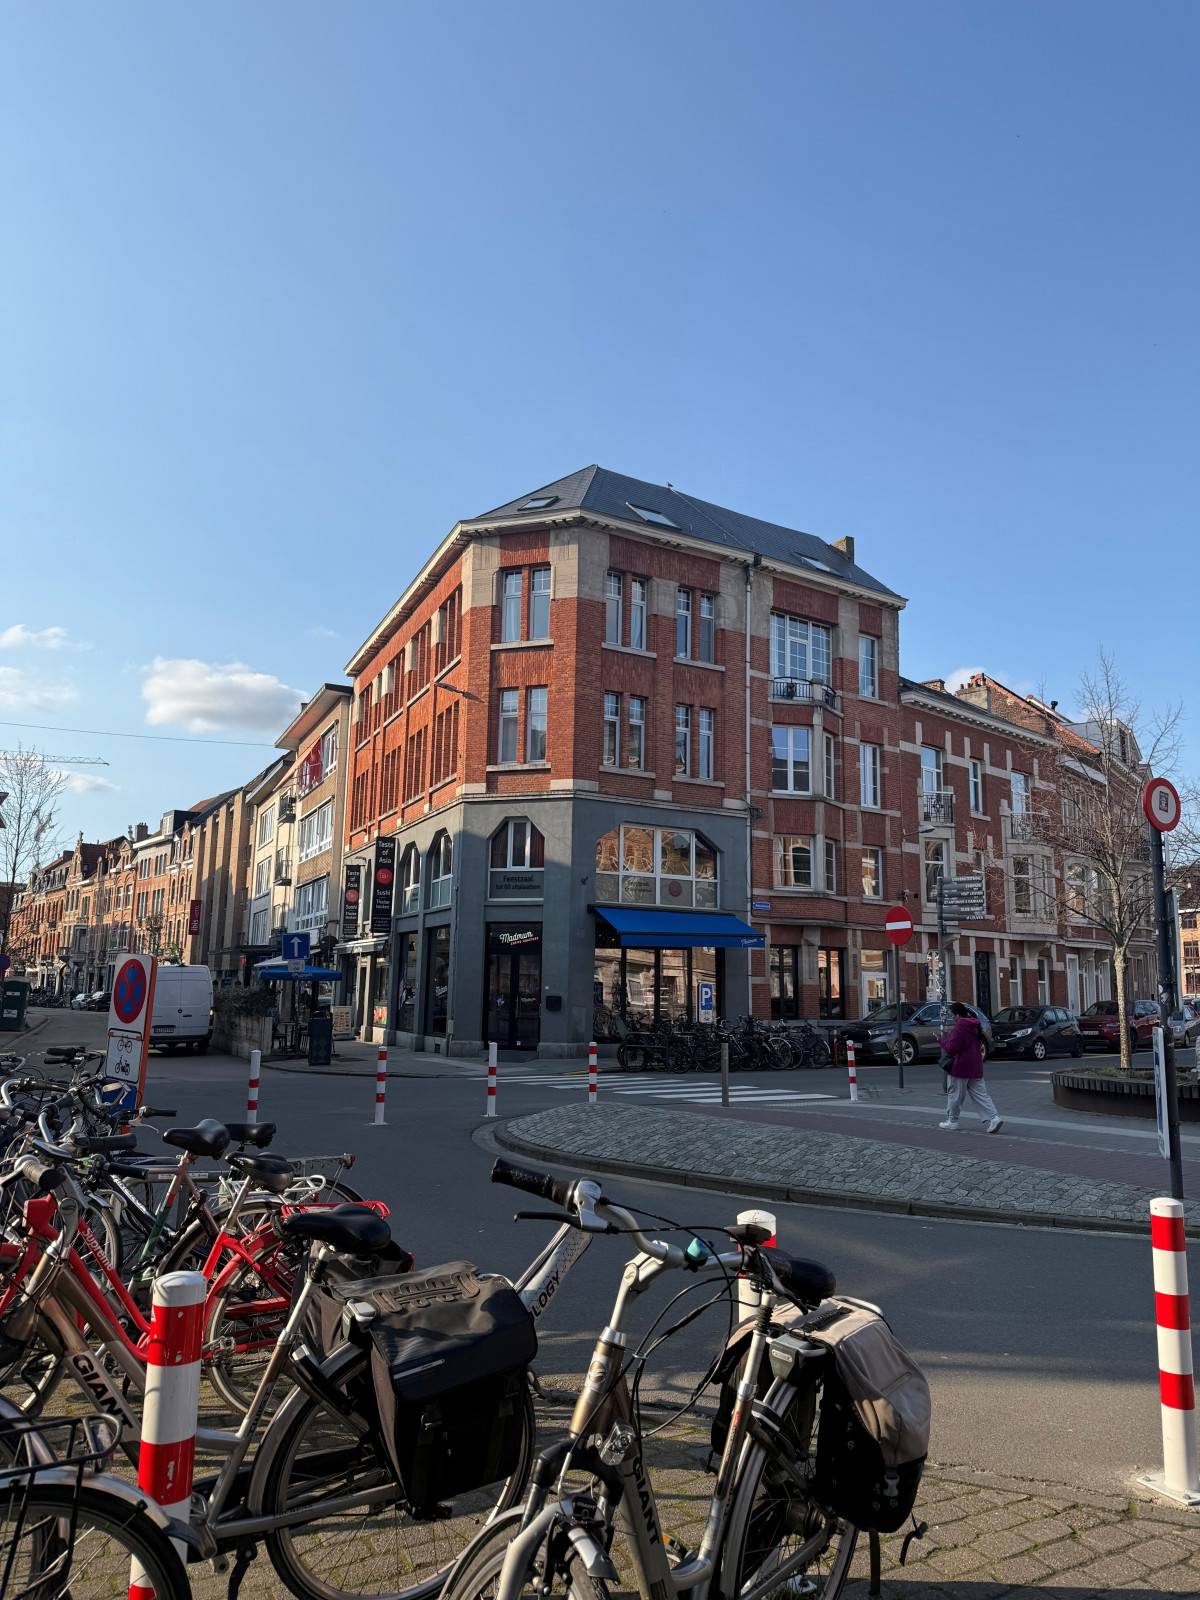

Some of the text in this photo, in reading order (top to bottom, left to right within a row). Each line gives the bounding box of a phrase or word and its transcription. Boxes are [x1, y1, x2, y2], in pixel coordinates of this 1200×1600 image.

[702, 987, 711, 1006] P
[530, 1269, 562, 1318] LOGY
[72, 1354, 134, 1429] GIANT
[632, 1456, 660, 1545] GIANT
